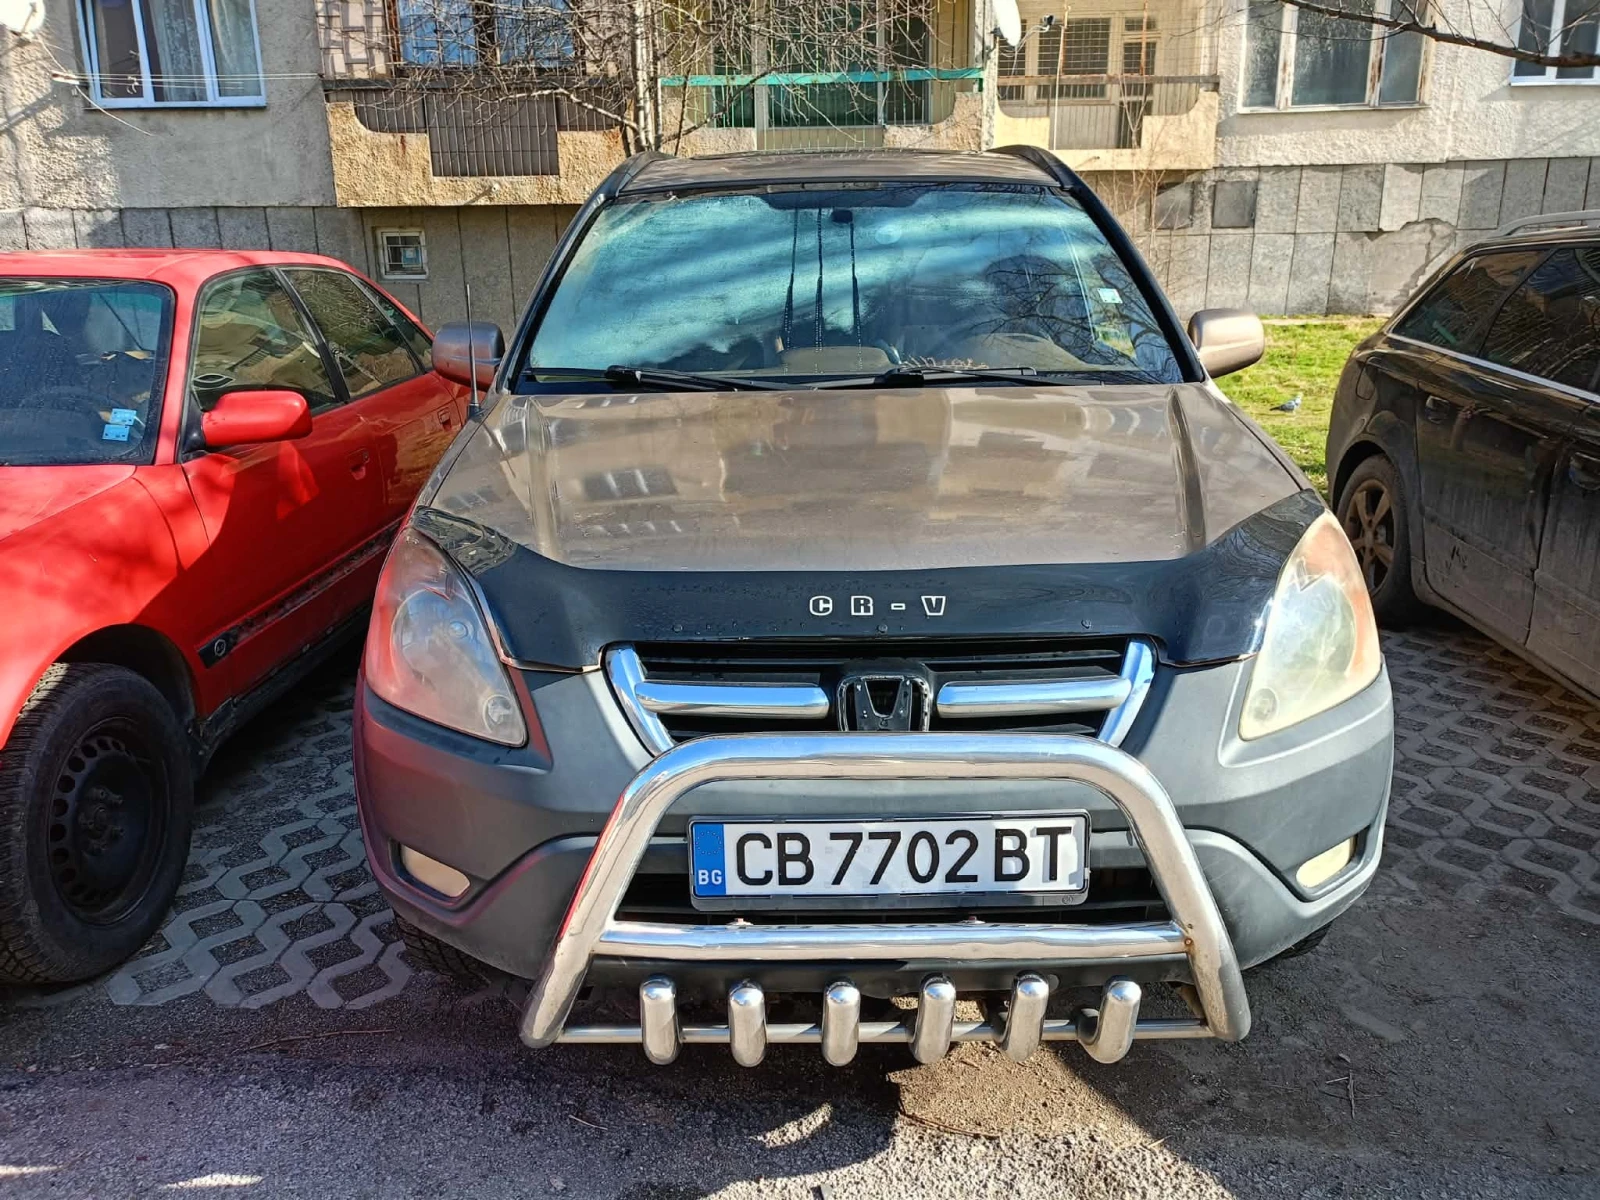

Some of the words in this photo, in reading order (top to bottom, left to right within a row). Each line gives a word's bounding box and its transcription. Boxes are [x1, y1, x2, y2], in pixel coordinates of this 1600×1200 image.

[735, 832, 815, 886] CB
[828, 831, 979, 885] 7702
[993, 827, 1073, 882] BT
[698, 869, 722, 885] BG
